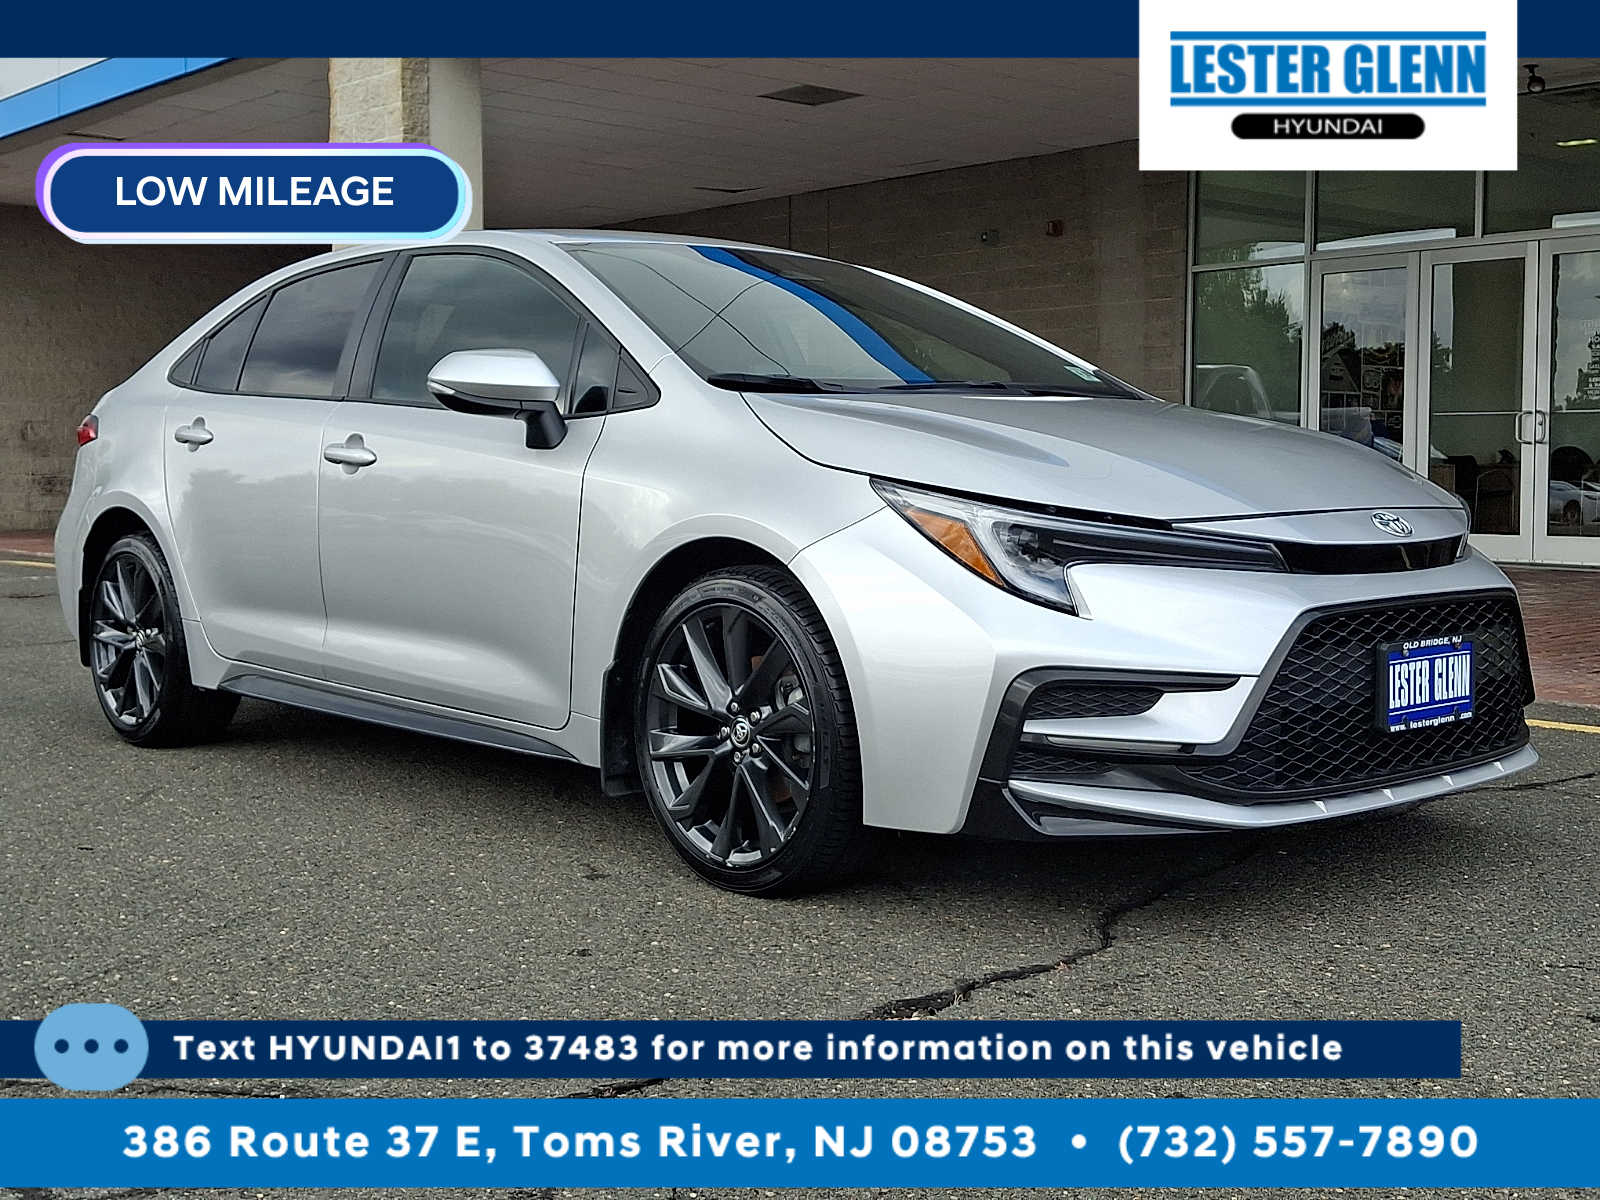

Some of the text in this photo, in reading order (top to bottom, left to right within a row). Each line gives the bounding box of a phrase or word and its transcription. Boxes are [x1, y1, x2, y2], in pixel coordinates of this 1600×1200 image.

[1403, 641, 1419, 650] OLD
[1452, 635, 1462, 643] NJ
[1389, 654, 1471, 709] LESTER GLENN
